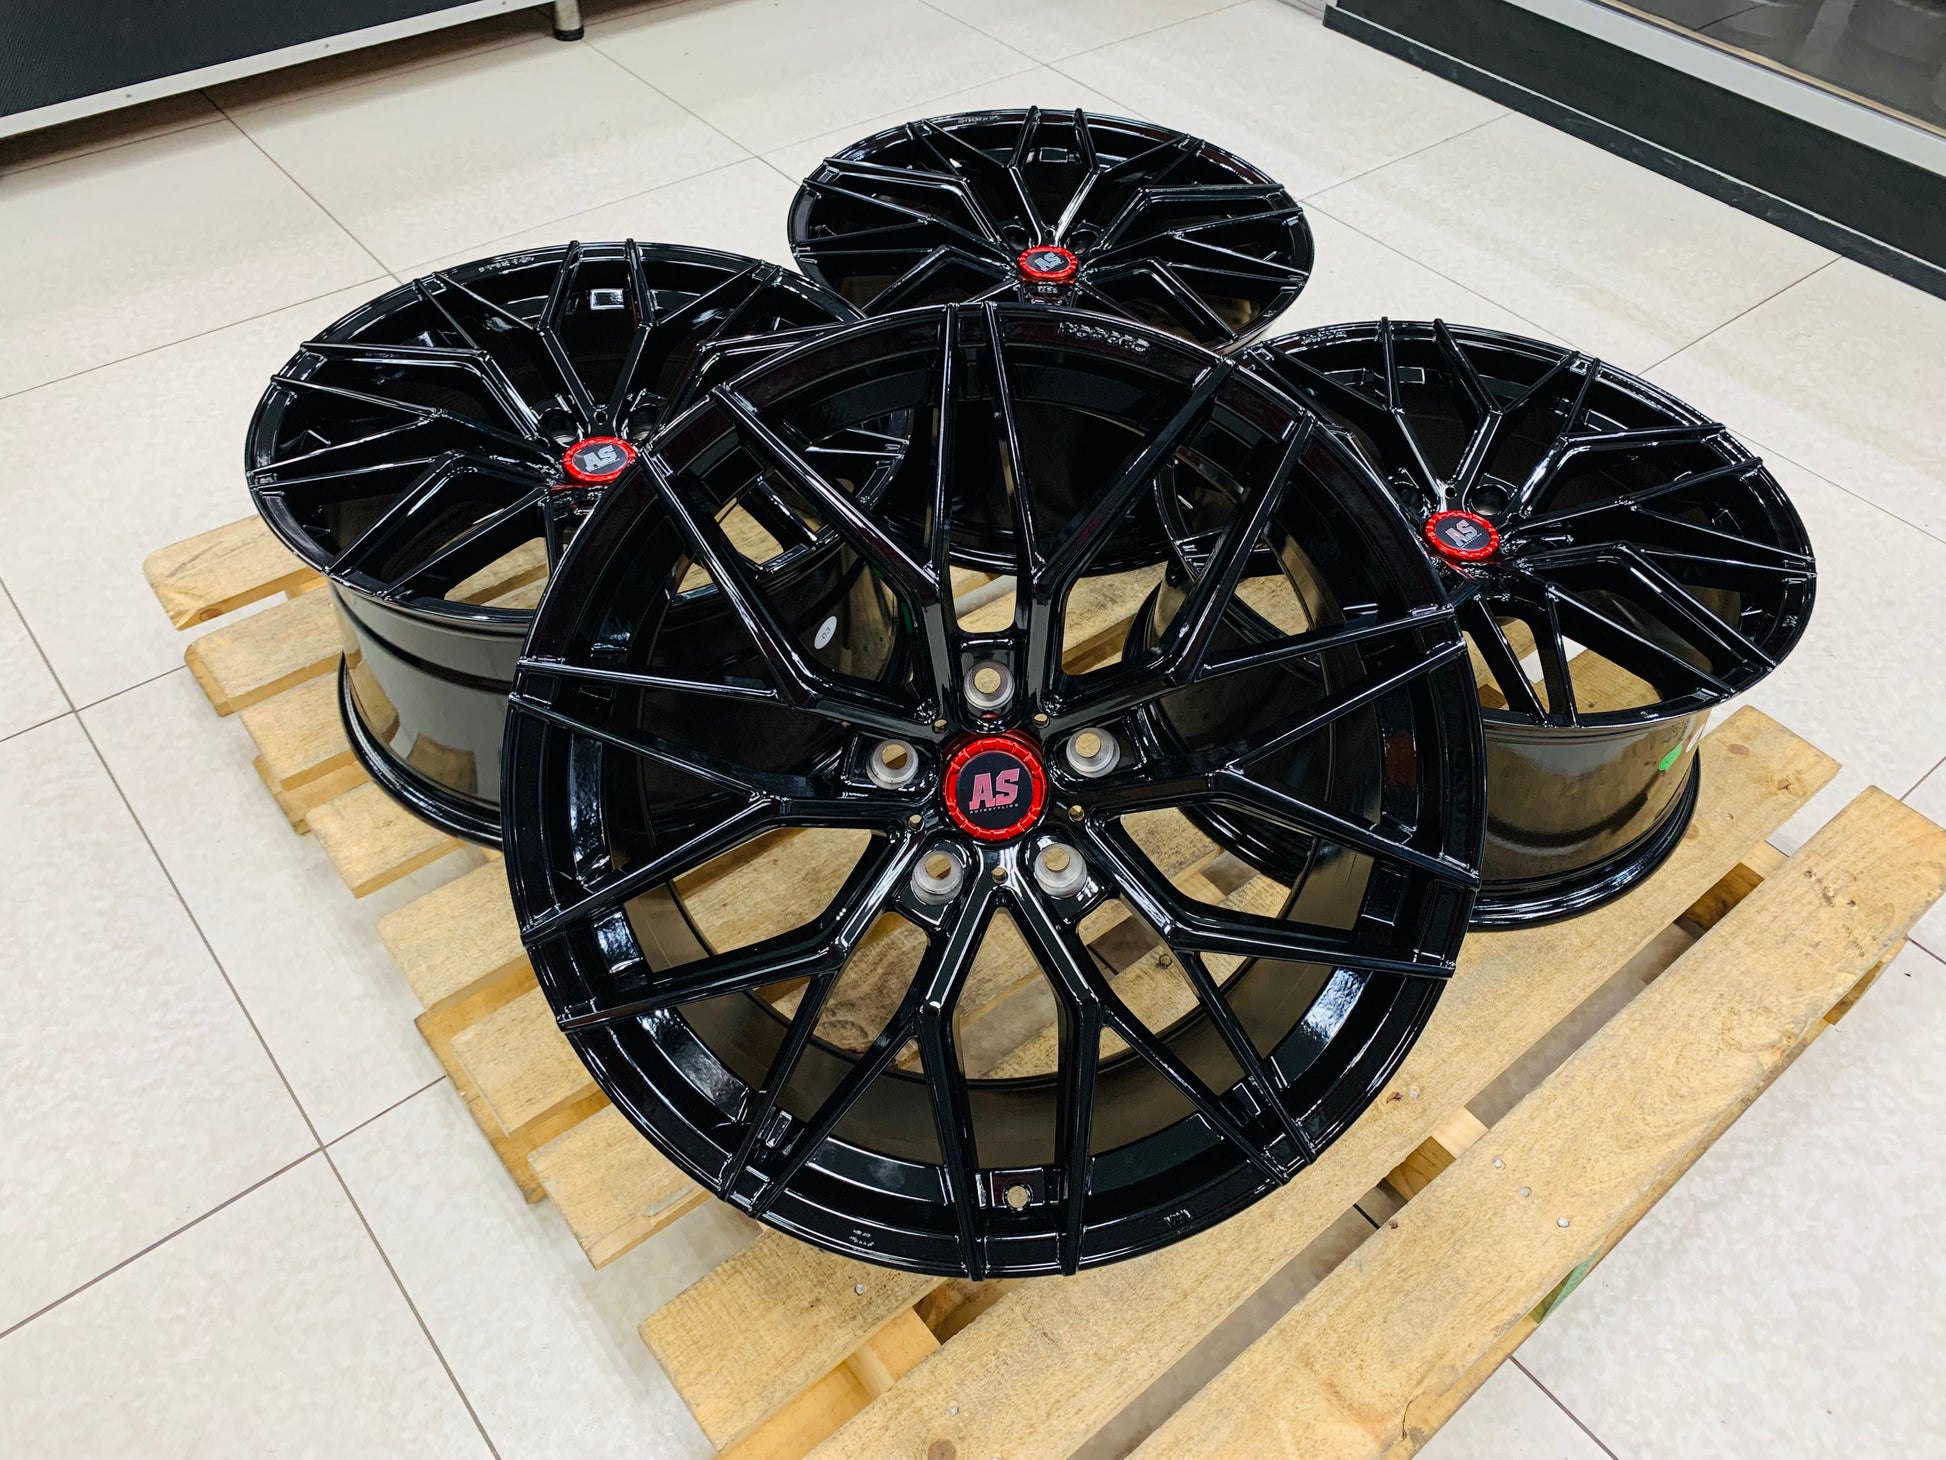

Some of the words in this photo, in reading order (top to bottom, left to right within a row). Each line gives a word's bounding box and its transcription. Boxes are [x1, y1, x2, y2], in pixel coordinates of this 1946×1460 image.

[583, 445, 617, 472] AS
[1445, 519, 1478, 546] AS
[968, 768, 1020, 810] AS
